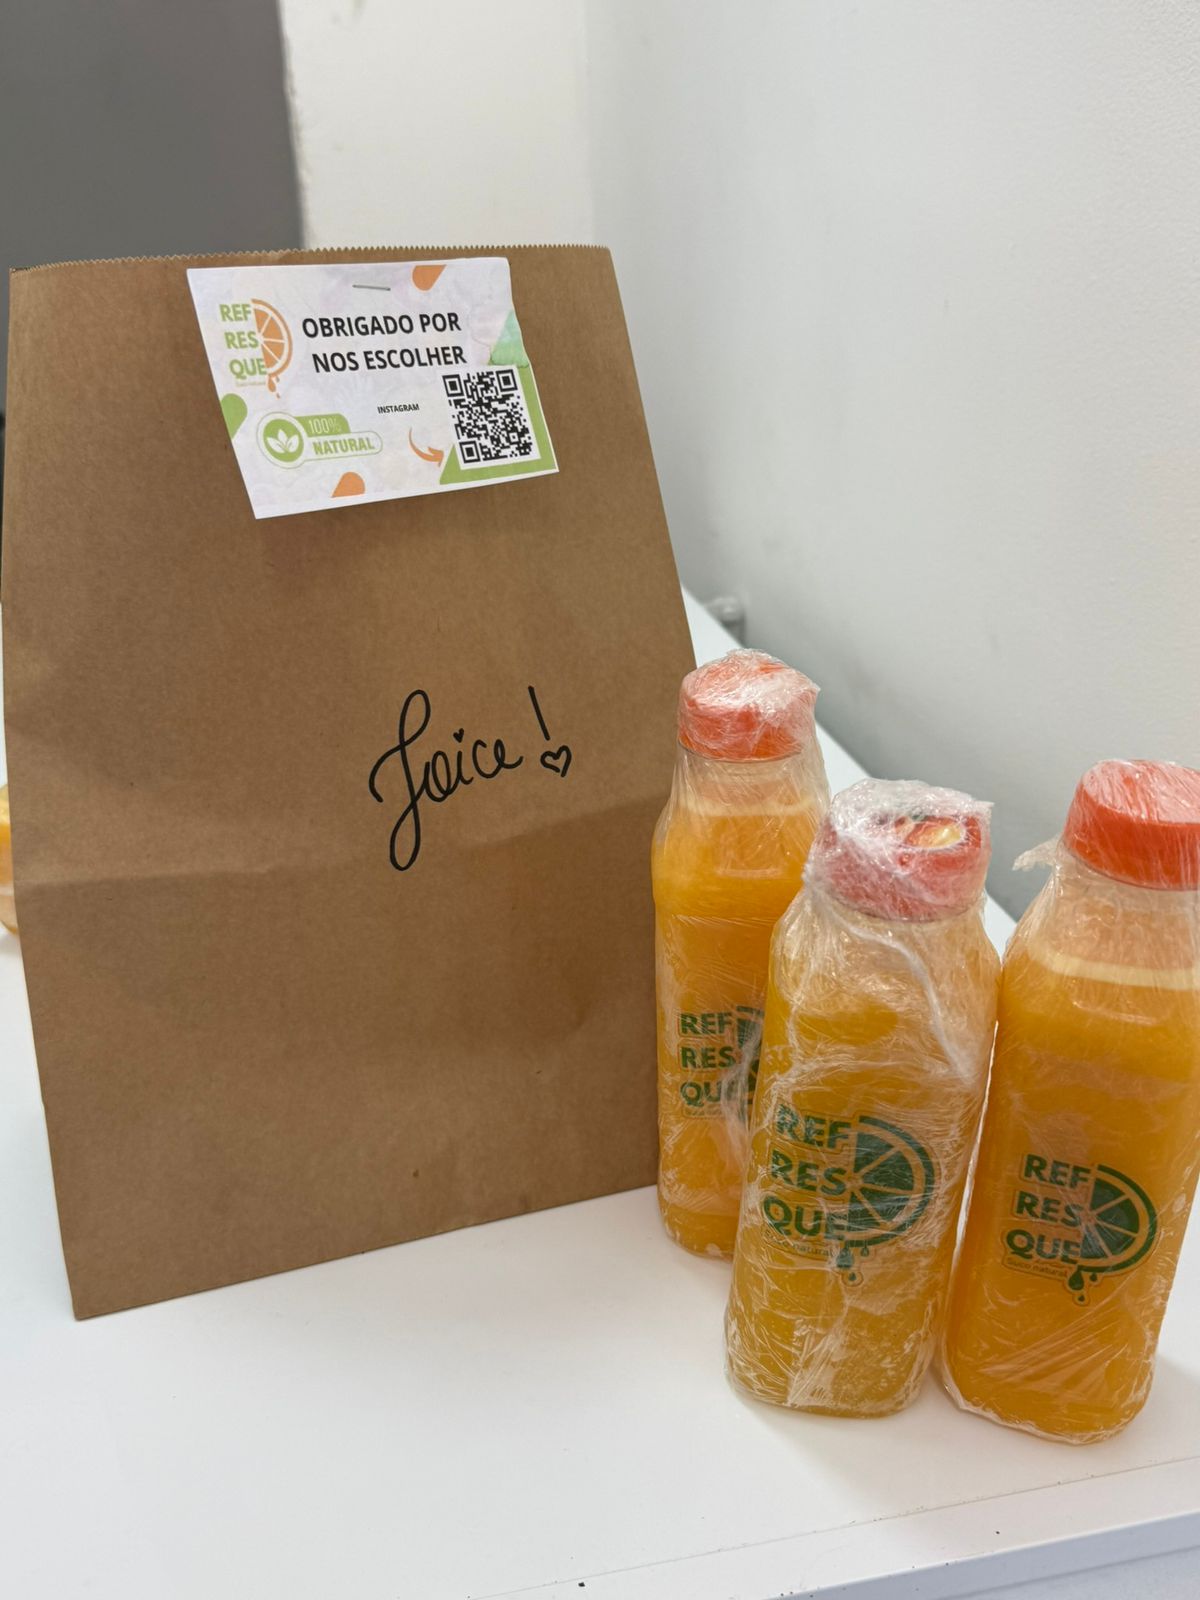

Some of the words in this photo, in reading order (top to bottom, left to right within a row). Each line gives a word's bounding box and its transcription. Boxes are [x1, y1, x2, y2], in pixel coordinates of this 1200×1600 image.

[219, 303, 251, 322] REF
[302, 315, 414, 338] OBRIGADO
[419, 312, 462, 333] POR
[224, 331, 259, 349] RES
[229, 358, 267, 380] QUE
[312, 352, 360, 373] NOS
[363, 346, 467, 370] ESCOLHER
[376, 403, 420, 414] INSTAGRAM
[308, 417, 343, 434] 100%
[312, 437, 376, 456] NATURAL
[680, 1011, 733, 1036] REF
[680, 1046, 736, 1070] RES
[776, 1103, 852, 1150] REF
[771, 1149, 847, 1196] RES
[1024, 1153, 1092, 1189] REF
[763, 1196, 846, 1241] QUE
[1016, 1190, 1083, 1228] RES
[1006, 1228, 1080, 1265] QUE
